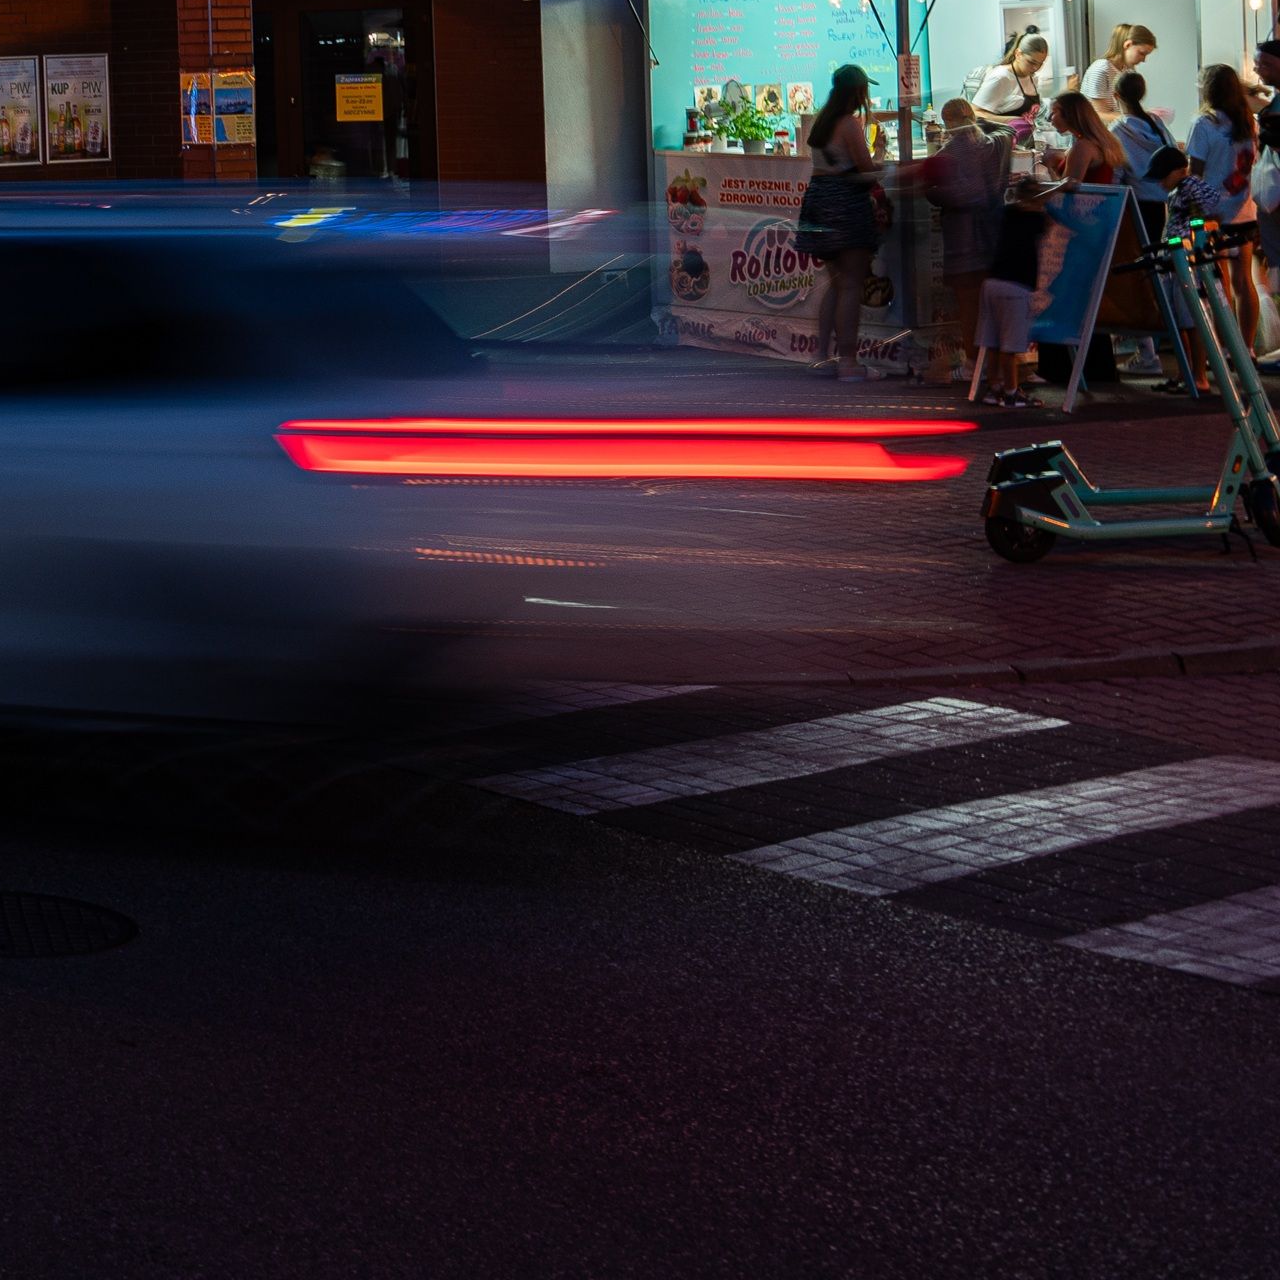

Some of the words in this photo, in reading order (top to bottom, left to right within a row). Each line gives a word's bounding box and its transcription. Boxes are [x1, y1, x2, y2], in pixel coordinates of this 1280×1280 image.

[50, 82, 70, 96] KUP
[721, 179, 747, 190] JEST
[749, 180, 795, 194] PYSZNIE,
[720, 194, 764, 205] ZDROWO
[766, 195, 770, 206] I
[747, 283, 773, 297] LODY
[773, 276, 815, 294] TAJSKIE
[734, 328, 778, 347] Rollove
[790, 333, 819, 354] LOD
